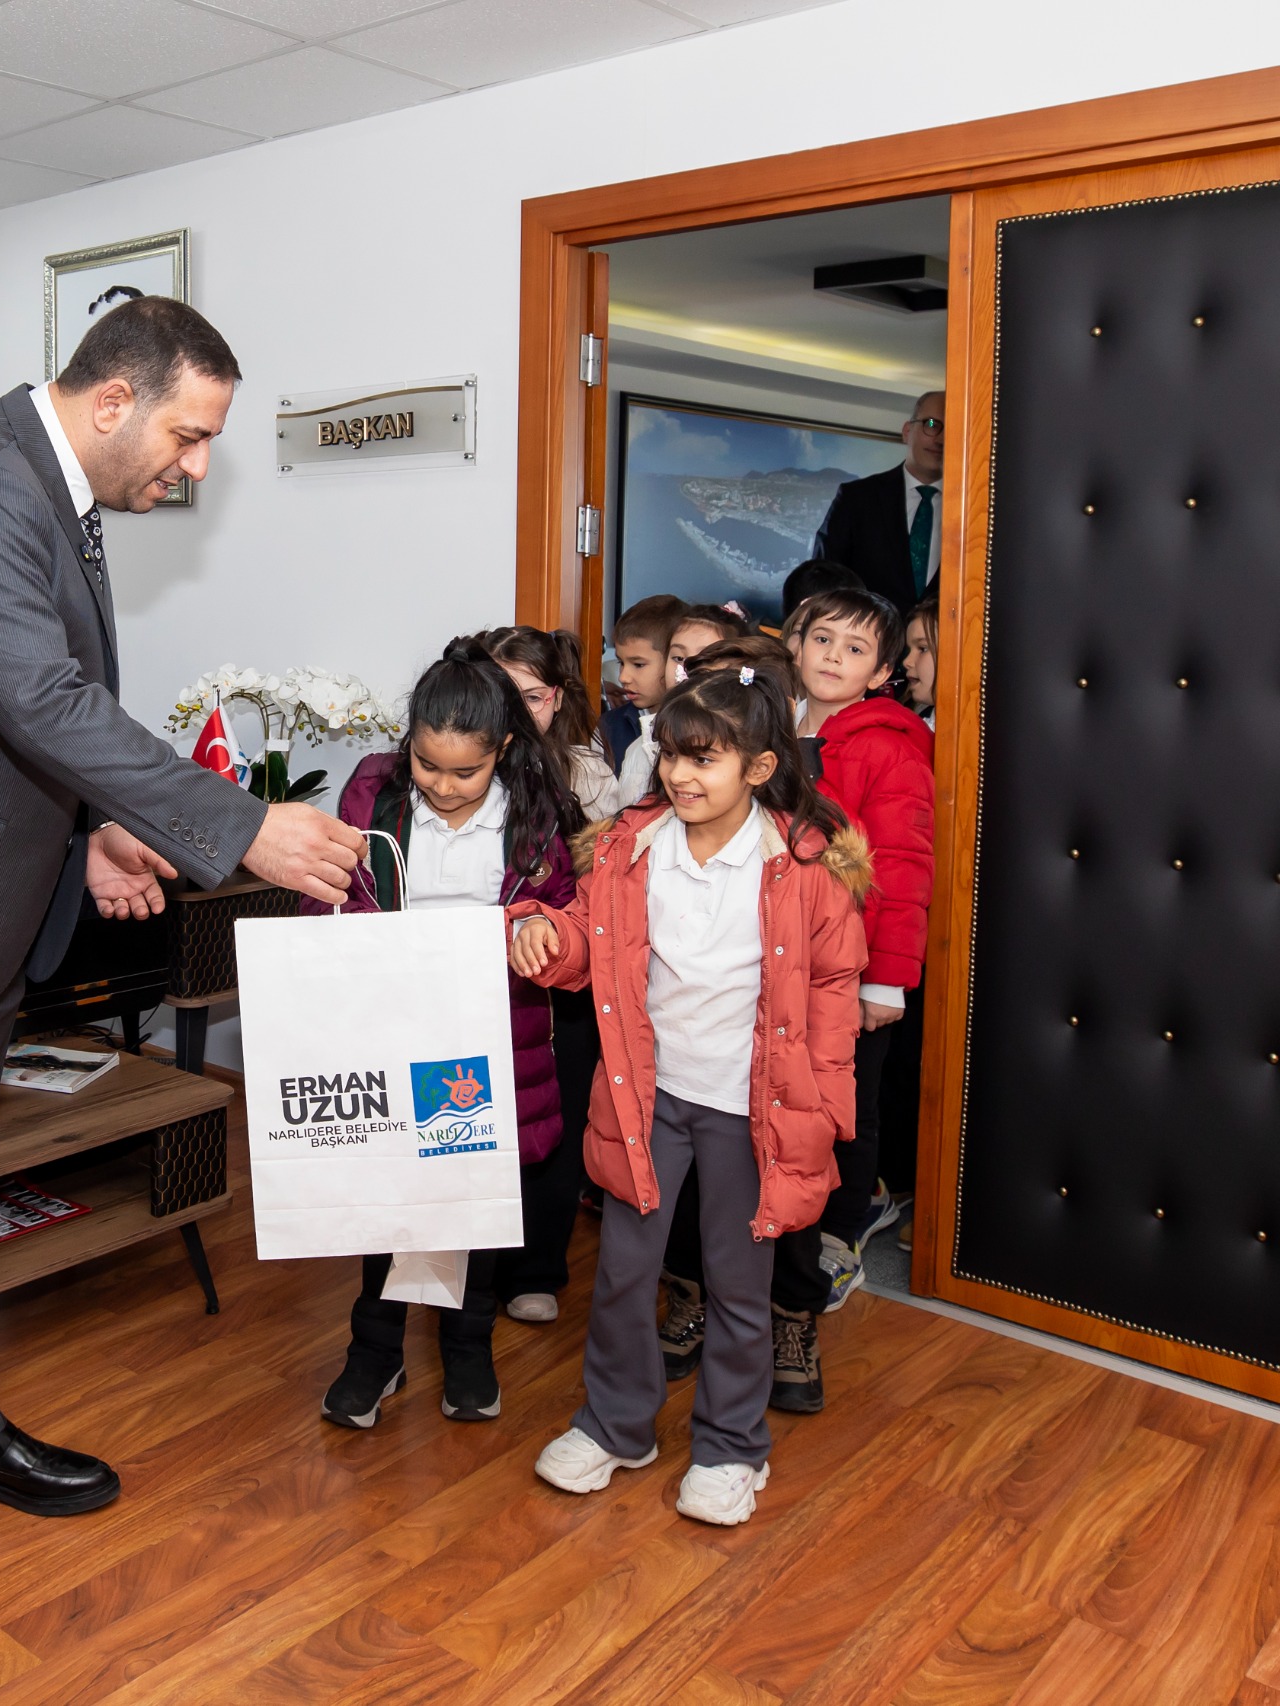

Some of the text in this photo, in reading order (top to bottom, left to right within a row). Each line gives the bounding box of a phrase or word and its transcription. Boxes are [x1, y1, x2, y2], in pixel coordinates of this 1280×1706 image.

[318, 411, 414, 449] BAŞKAN
[279, 1070, 387, 1099] ERMAN
[281, 1091, 390, 1126] UZUN
[268, 1119, 408, 1141] NARLIDERE BELEDİYE
[310, 1134, 368, 1149] BAŞKANI
